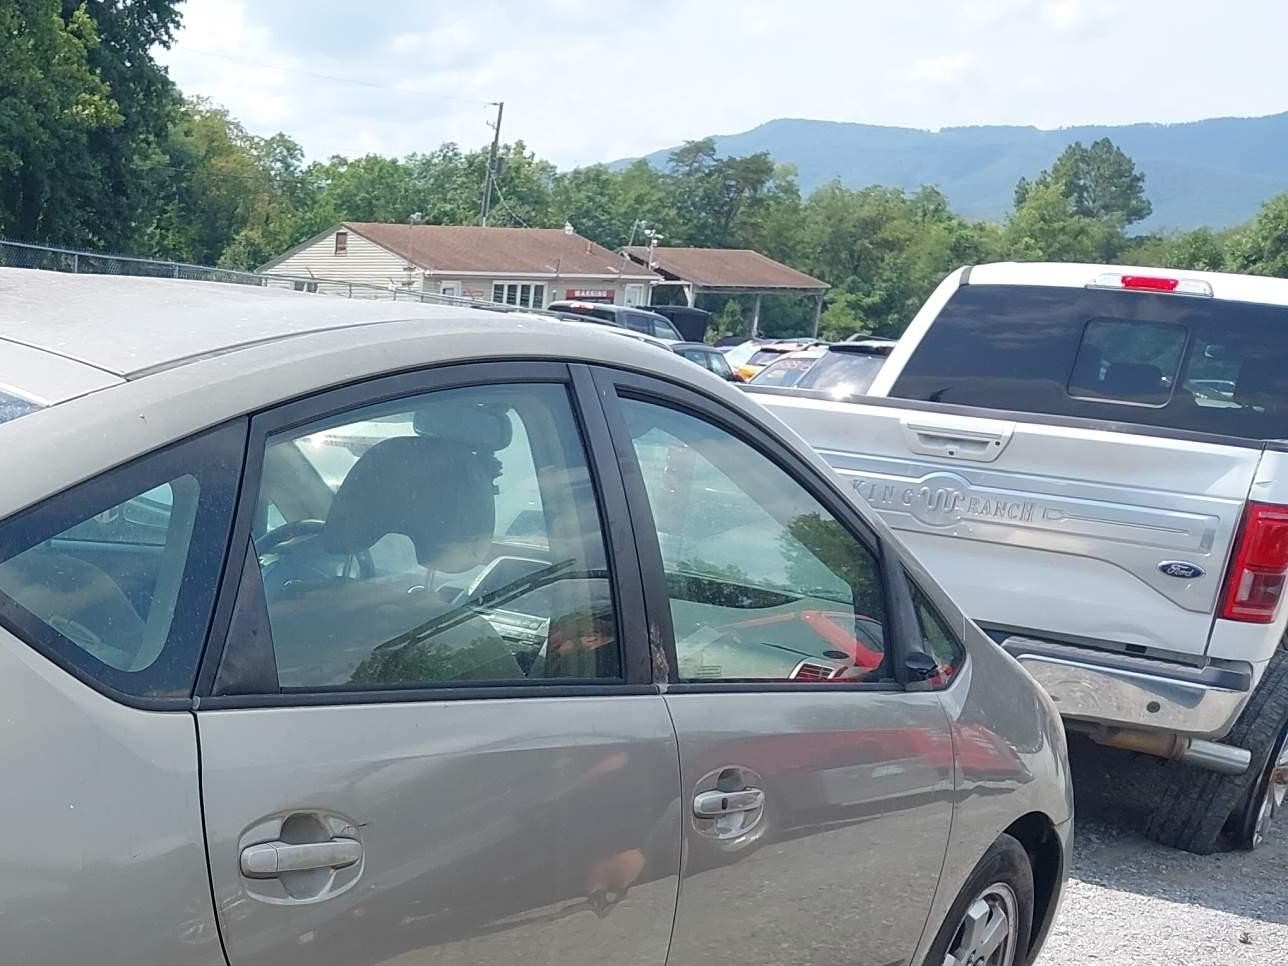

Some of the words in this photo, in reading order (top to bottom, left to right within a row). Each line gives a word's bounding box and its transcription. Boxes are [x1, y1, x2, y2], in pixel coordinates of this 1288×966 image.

[853, 479, 913, 506] KING
[966, 494, 1034, 522] RANCH
[1167, 564, 1195, 577] Ford
